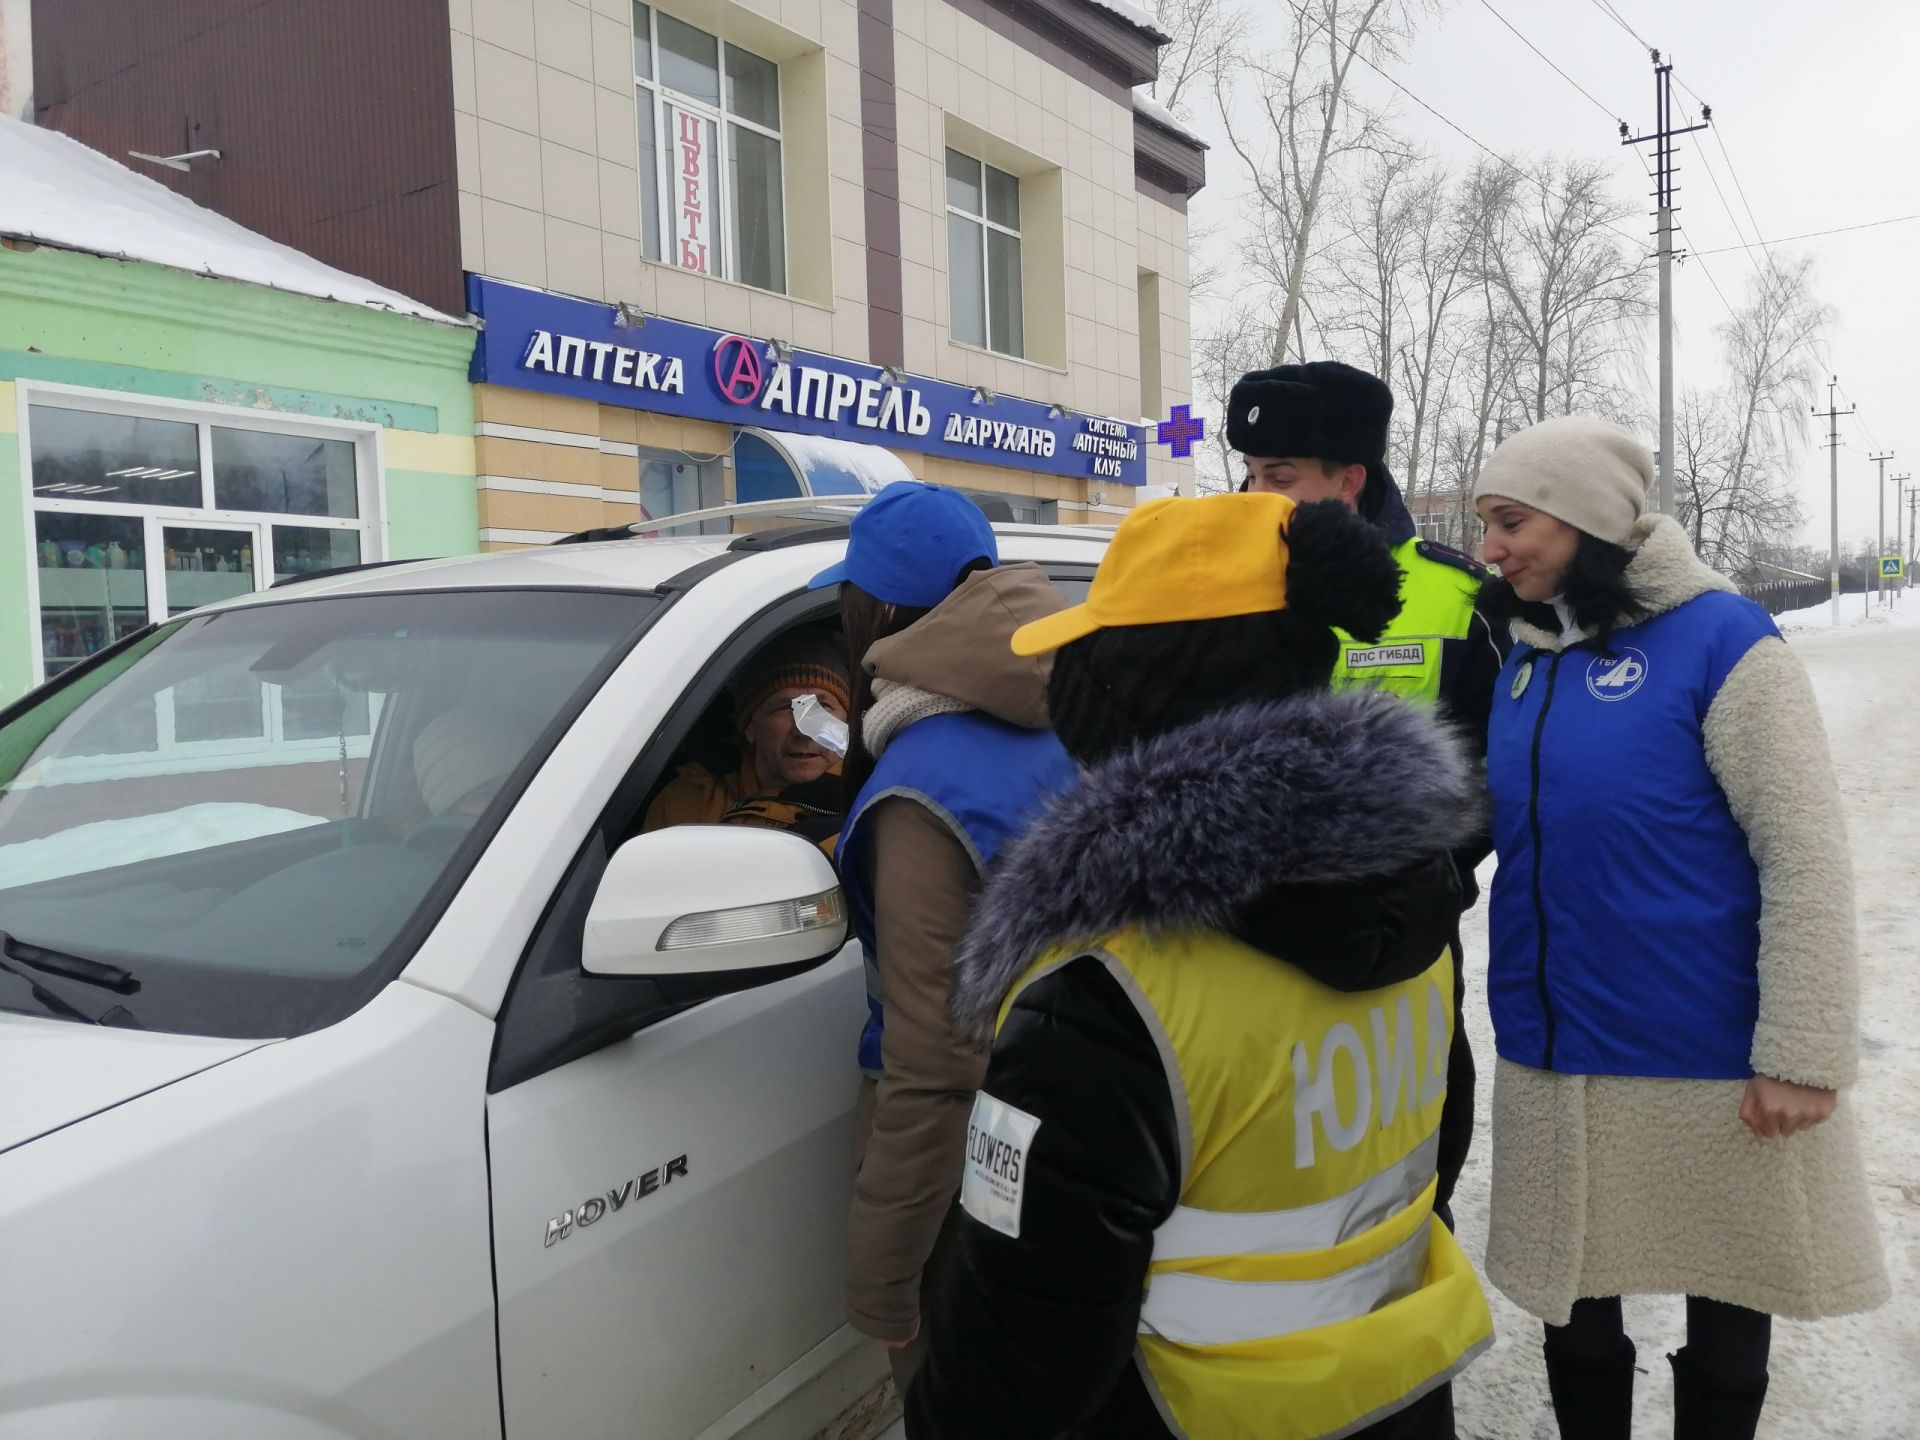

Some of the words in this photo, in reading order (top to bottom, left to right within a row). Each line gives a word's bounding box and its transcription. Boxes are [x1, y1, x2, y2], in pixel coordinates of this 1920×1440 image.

[679, 112, 707, 273] ЦВЕТЫ
[524, 329, 685, 395] АПТЕКА
[760, 362, 931, 436] АПРЕЛЬ
[1073, 433, 1138, 460] АПТЕЧНЫЙ
[1094, 457, 1122, 477] КЛУБ
[1350, 652, 1376, 664] ДПС
[1378, 648, 1420, 660] ГИБДД
[1292, 982, 1449, 1169] ЮИД
[969, 1124, 1021, 1183] FLOWERS
[544, 1153, 689, 1248] HOVER
